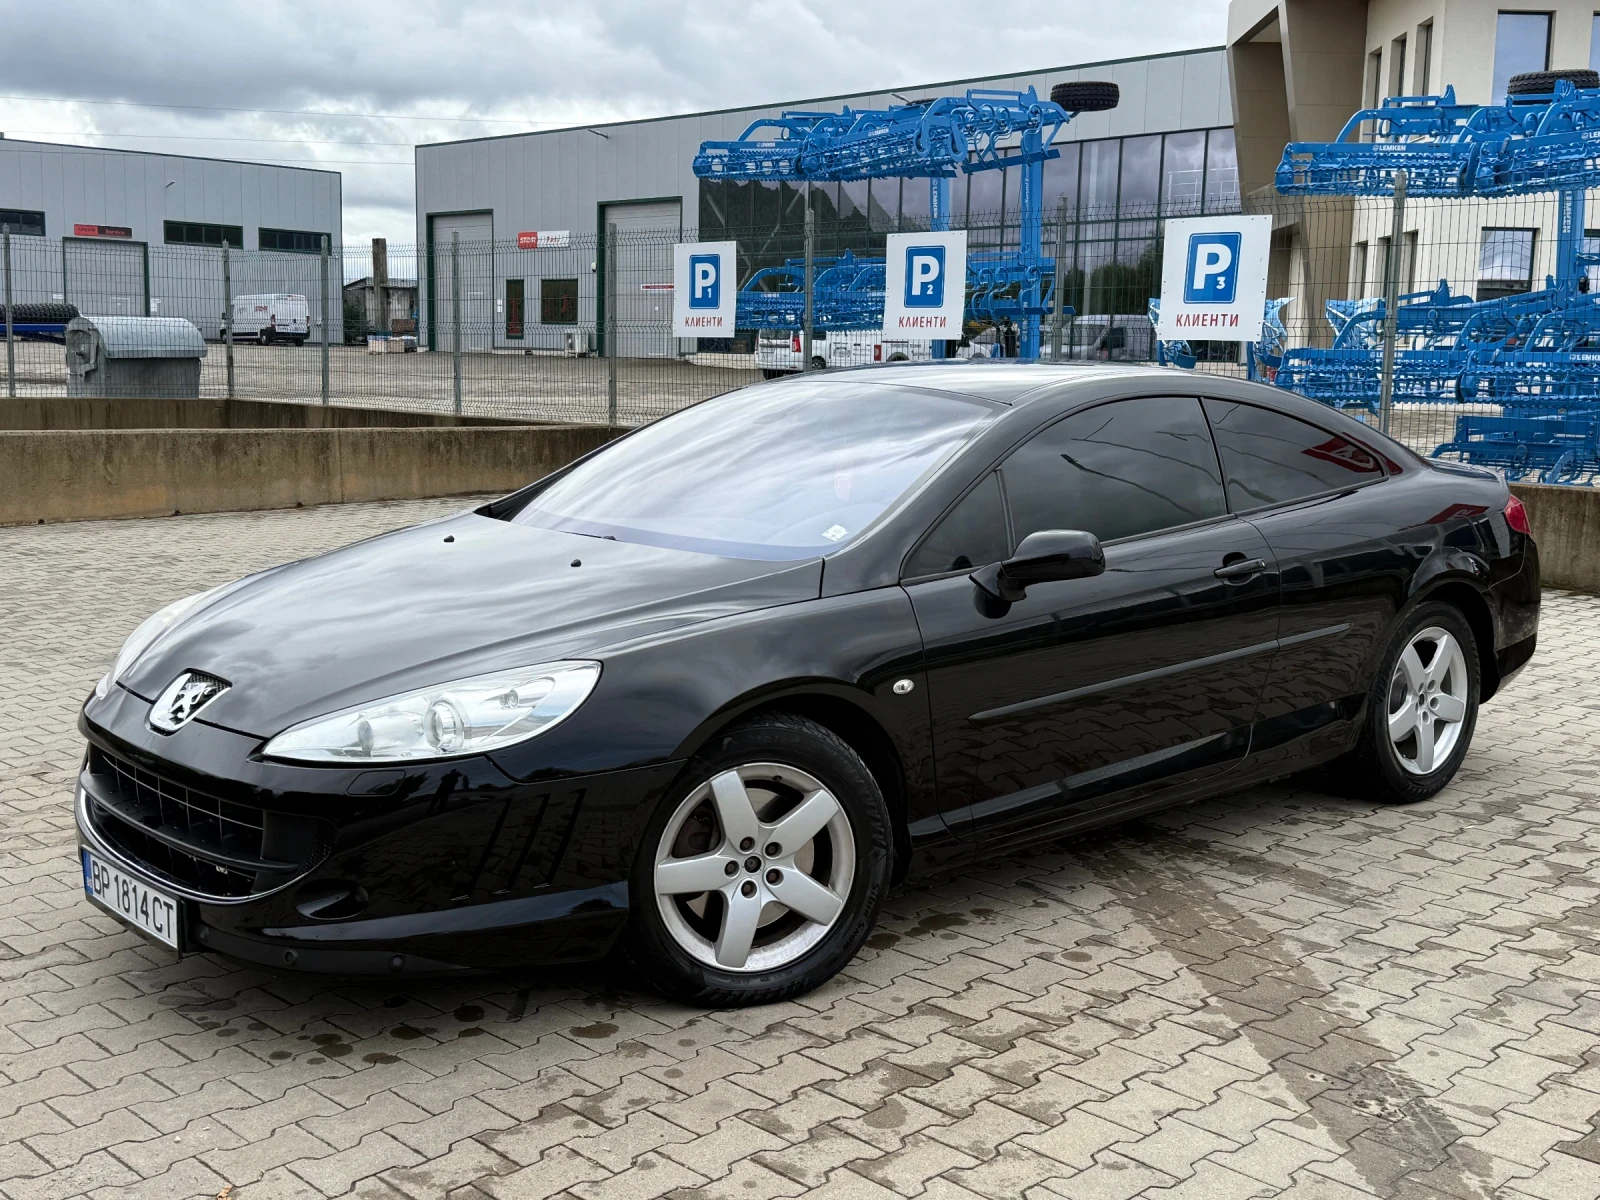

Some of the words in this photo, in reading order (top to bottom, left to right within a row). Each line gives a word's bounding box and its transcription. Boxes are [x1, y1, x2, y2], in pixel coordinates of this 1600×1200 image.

[684, 316, 723, 328] КЛИЕНТИ
[898, 316, 947, 328] КЛИЕНТИ
[1175, 313, 1239, 328] КЛИЕНТИ
[92, 859, 110, 899] BP
